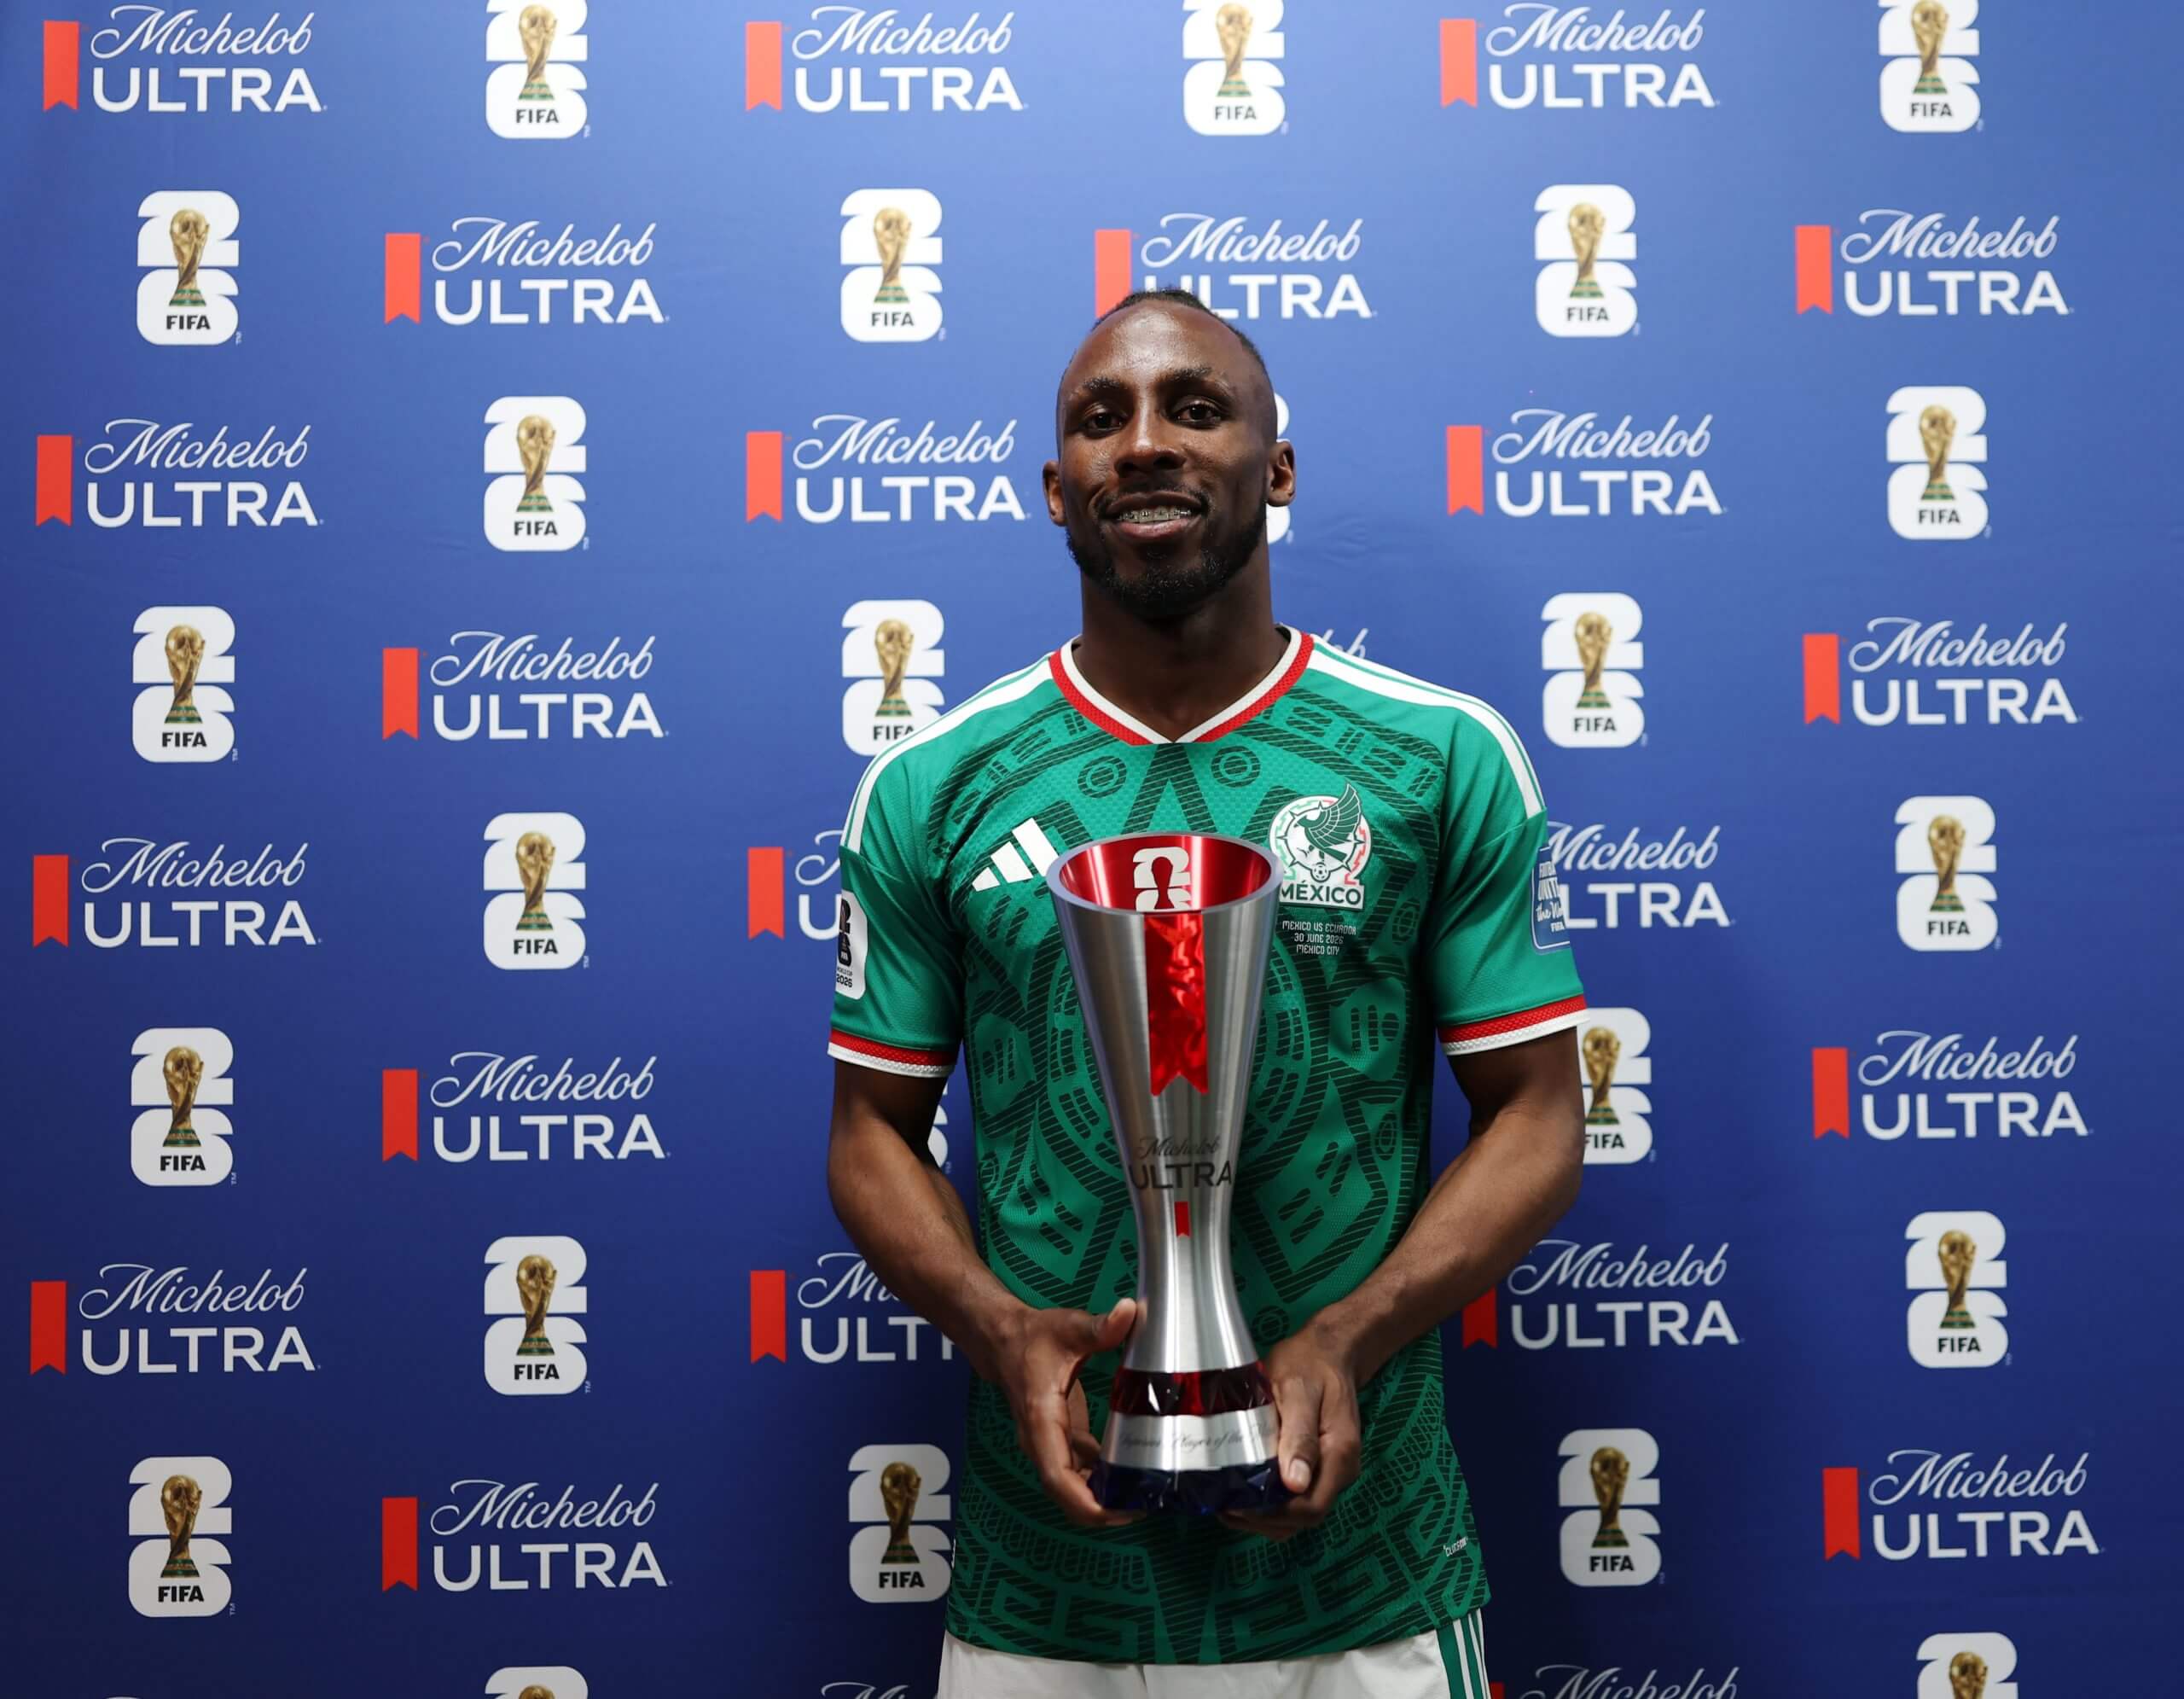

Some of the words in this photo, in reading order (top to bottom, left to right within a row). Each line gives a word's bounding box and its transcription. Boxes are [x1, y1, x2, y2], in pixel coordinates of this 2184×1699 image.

[91, 5, 314, 58] Michelob
[792, 6, 1014, 59] Michelob
[1486, 3, 1704, 56] Michelob
[94, 68, 321, 112] ULTRA
[796, 67, 1022, 112] ULTRA
[1490, 64, 1714, 109] ULTRA
[515, 108, 559, 124] FIFA
[1214, 106, 1257, 120] FIFA
[1910, 102, 1953, 117] FIFA
[433, 218, 656, 271] Michelob
[1141, 213, 1362, 267] Michelob
[1841, 210, 2059, 264] Michelob
[436, 279, 664, 324] ULTRA
[1566, 306, 1609, 322] FIFA
[1845, 271, 2068, 316] ULTRA
[166, 315, 211, 330] FIFA
[871, 311, 914, 327] FIFA
[85, 419, 311, 473] Michelob
[793, 415, 1017, 469] Michelob
[1492, 409, 1712, 463] Michelob
[88, 482, 317, 527] ULTRA
[797, 476, 1025, 522] ULTRA
[1496, 470, 1721, 516] ULTRA
[514, 521, 558, 536] FIFA
[1918, 509, 1960, 524] FIFA
[431, 631, 655, 686] Michelob
[1849, 618, 2067, 672] Michelob
[434, 693, 663, 740] ULTRA
[1574, 717, 1617, 732] FIFA
[1853, 679, 2077, 725] ULTRA
[161, 731, 207, 748] FIFA
[82, 838, 307, 893] Michelob
[1281, 880, 1361, 905] MÉXICO
[1560, 882, 1730, 928] LTRA
[85, 901, 316, 947] ULTRA
[1282, 921, 1311, 931] MEXICO
[1325, 923, 1356, 935] ECUADOR
[1294, 933, 1304, 942] 30
[1306, 934, 1324, 943] JUNE
[1326, 934, 1345, 945] 2026
[1927, 921, 1970, 935] FIFA
[514, 939, 558, 955] FIFA
[1297, 944, 1325, 955] MEXICO
[1327, 946, 1339, 955] CITY
[836, 974, 853, 987] 2026
[431, 1052, 656, 1107] Michelob
[1859, 1031, 2077, 1085] Michelob
[434, 1114, 665, 1161] ULTRA
[1862, 1092, 2088, 1139] ULTRA
[160, 1155, 206, 1172] FIFA
[1128, 1161, 1232, 1190] ULTRA
[1509, 1240, 1728, 1295] Michelob
[79, 1264, 307, 1318] Michelob
[1513, 1300, 1739, 1348] ULTRA
[1937, 1337, 1981, 1353] FIFA
[83, 1327, 315, 1375] ULTRA
[514, 1364, 560, 1381] FIFA
[1870, 1450, 2088, 1504] Michelob
[431, 1480, 658, 1535] Michelob
[1873, 1510, 2099, 1559] ULTRA
[434, 1542, 666, 1591] ULTRA
[879, 1570, 926, 1589] FIFA
[1589, 1555, 1635, 1573] FIFA
[158, 1585, 205, 1603] FIFA
